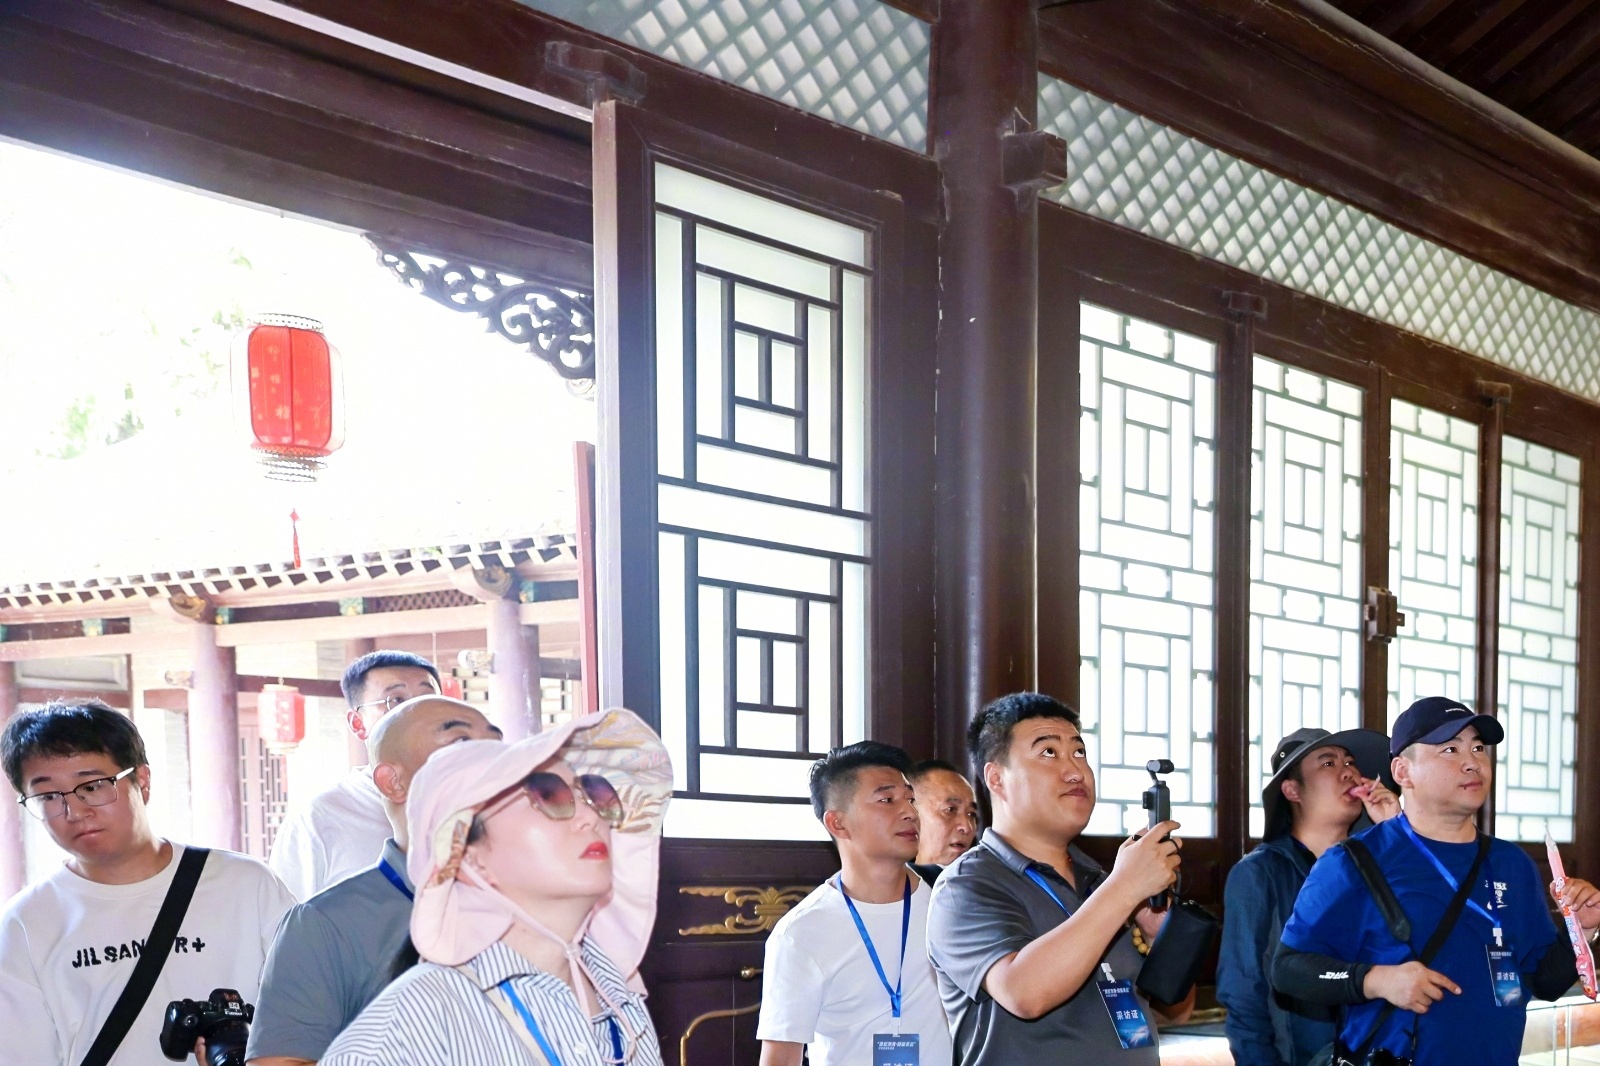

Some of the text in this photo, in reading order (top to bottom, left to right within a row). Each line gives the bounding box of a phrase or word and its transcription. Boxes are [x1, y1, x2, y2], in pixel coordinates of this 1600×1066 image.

[72, 947, 101, 968] JIL
[1115, 1009, 1139, 1020] 采访证
